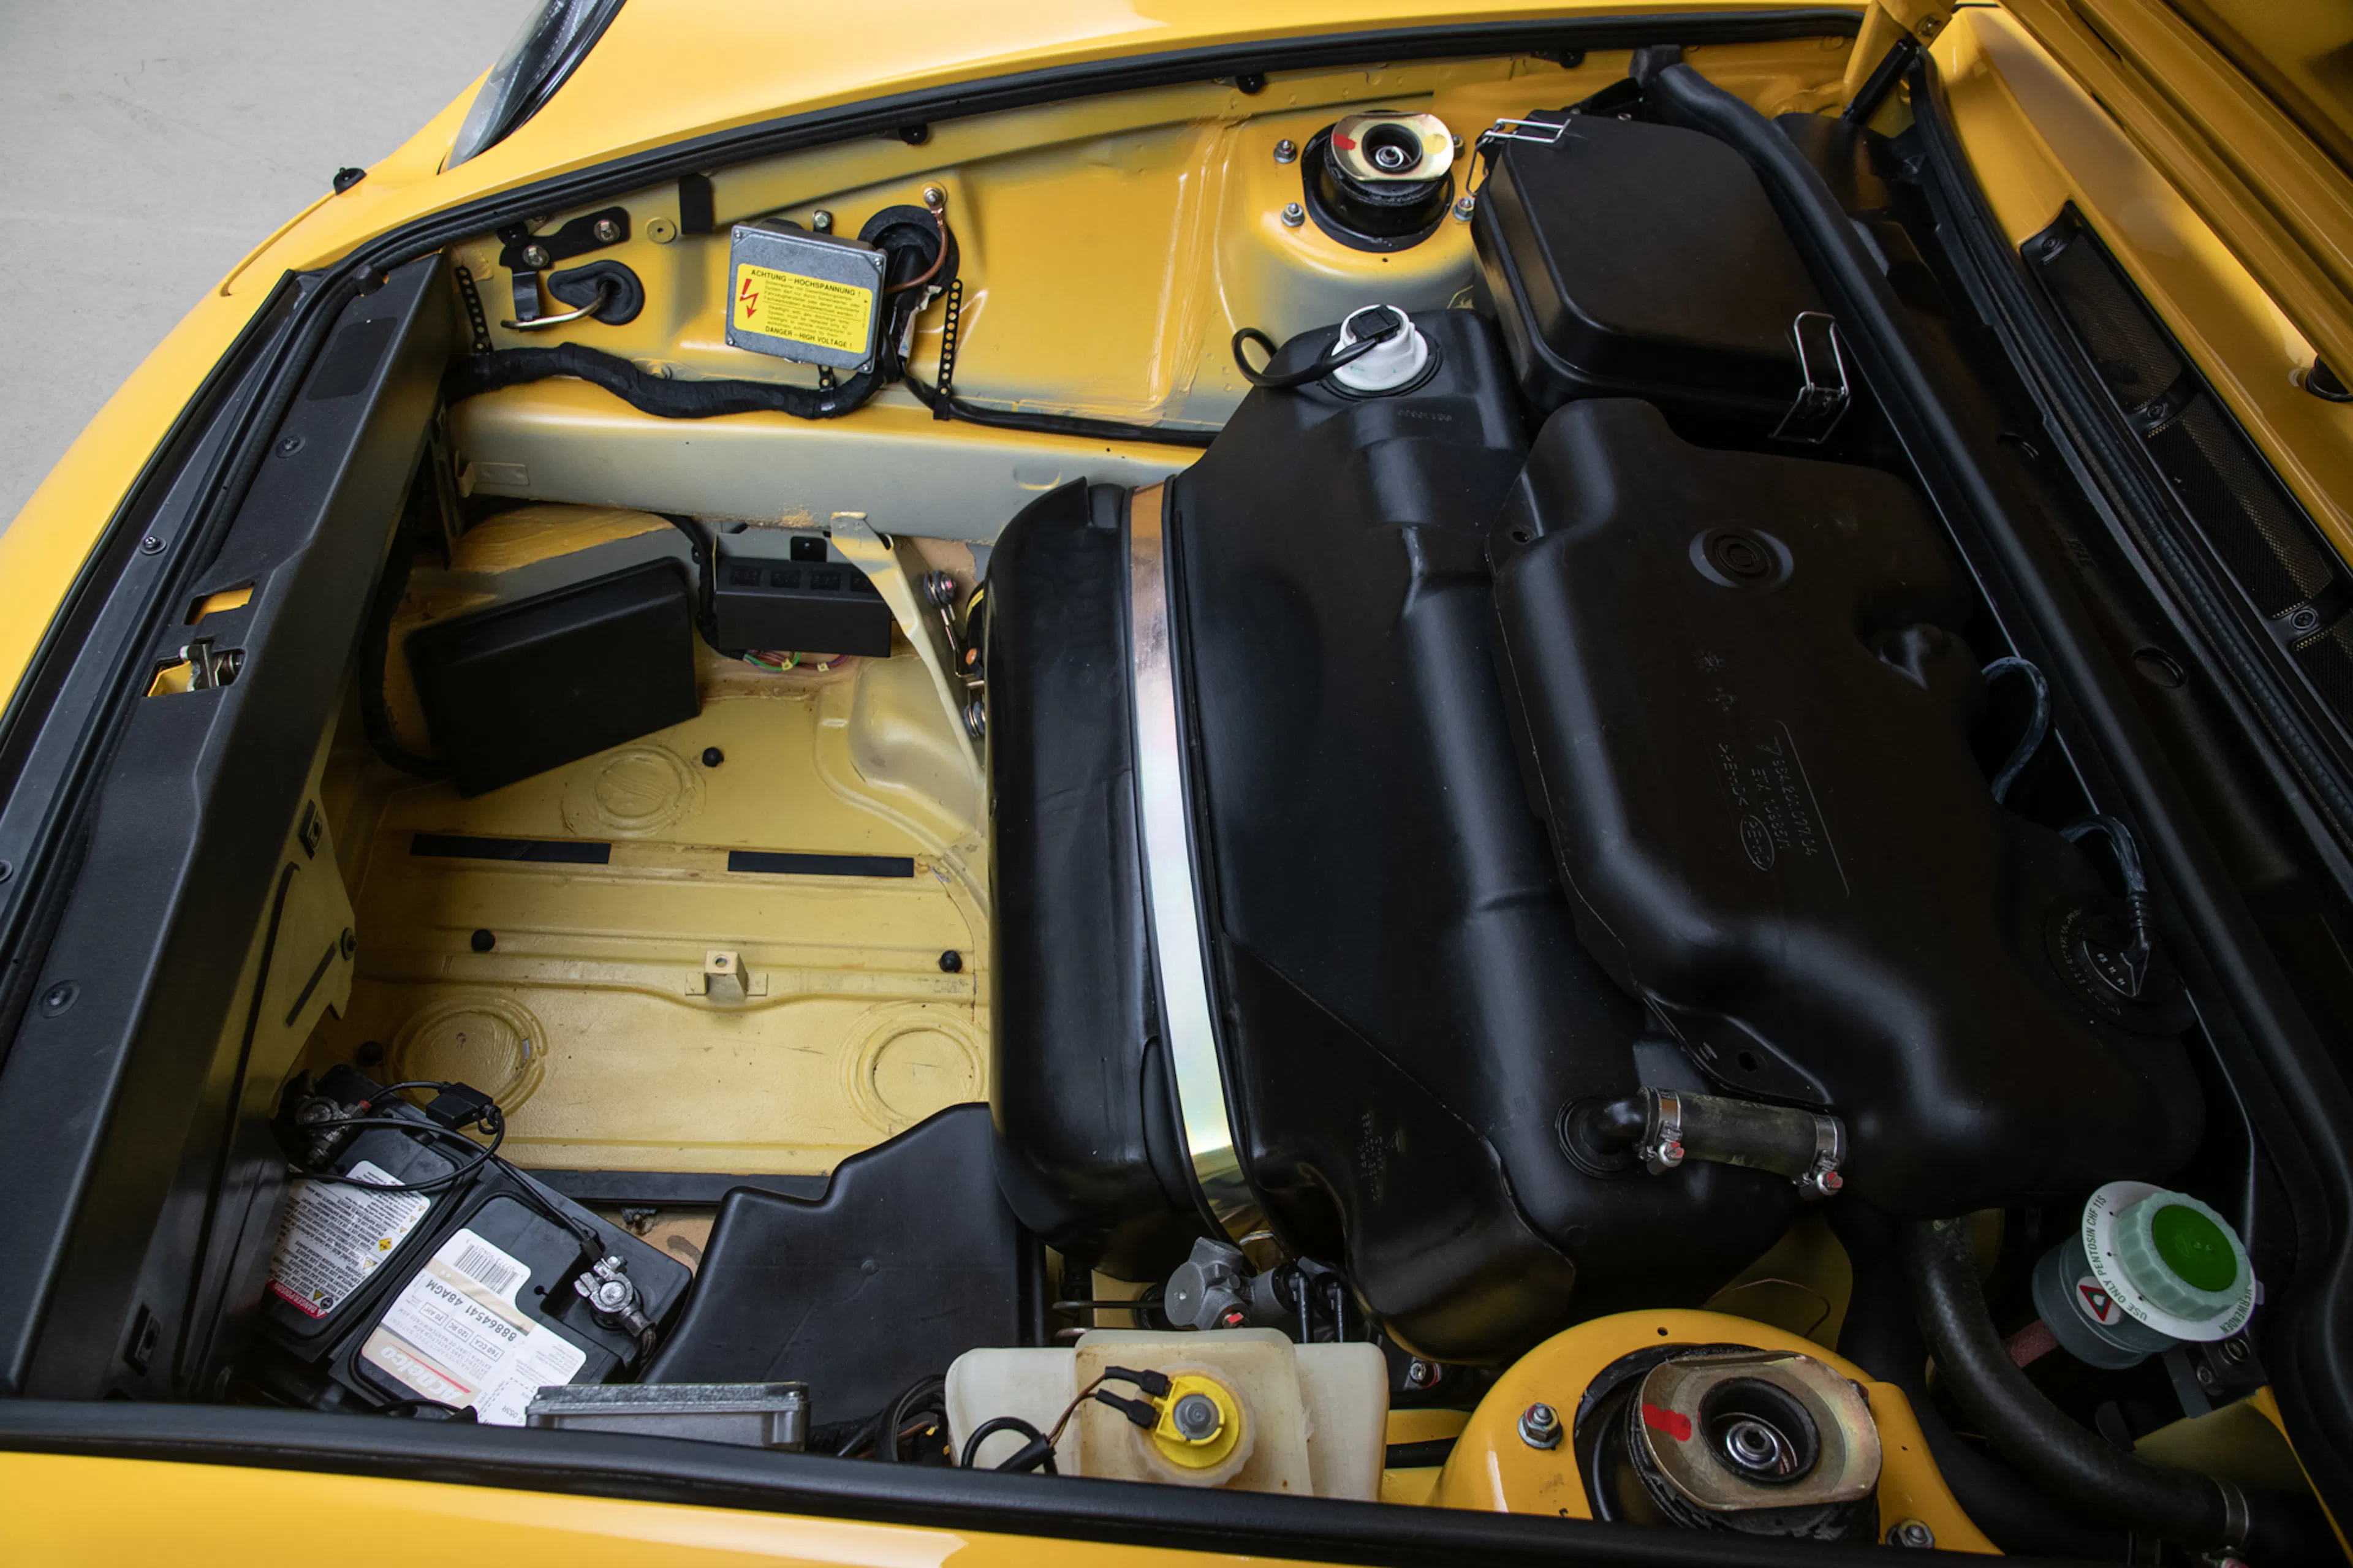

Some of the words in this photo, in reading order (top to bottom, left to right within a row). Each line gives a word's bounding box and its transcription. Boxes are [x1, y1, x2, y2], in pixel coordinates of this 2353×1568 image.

[751, 269, 786, 282] ACHTUNG
[794, 278, 855, 295] HOCHSPANNUNG
[765, 326, 792, 336] DANGER
[817, 336, 847, 347] VOLTAGE
[2093, 1195, 2106, 1209] 11S
[2086, 1208, 2098, 1225] CHF
[2086, 1227, 2106, 1276] PENTOSIN
[425, 1279, 464, 1308] 48AGM
[2103, 1279, 2126, 1303] ONLY
[434, 1312, 444, 1322] 70
[2126, 1303, 2147, 1320] USE
[447, 1322, 458, 1331] RC
[464, 1304, 518, 1342] 88864541
[457, 1328, 469, 1338] 120
[474, 1338, 488, 1350] CCA
[487, 1346, 500, 1357] 760
[378, 1346, 464, 1403] ACDelco
